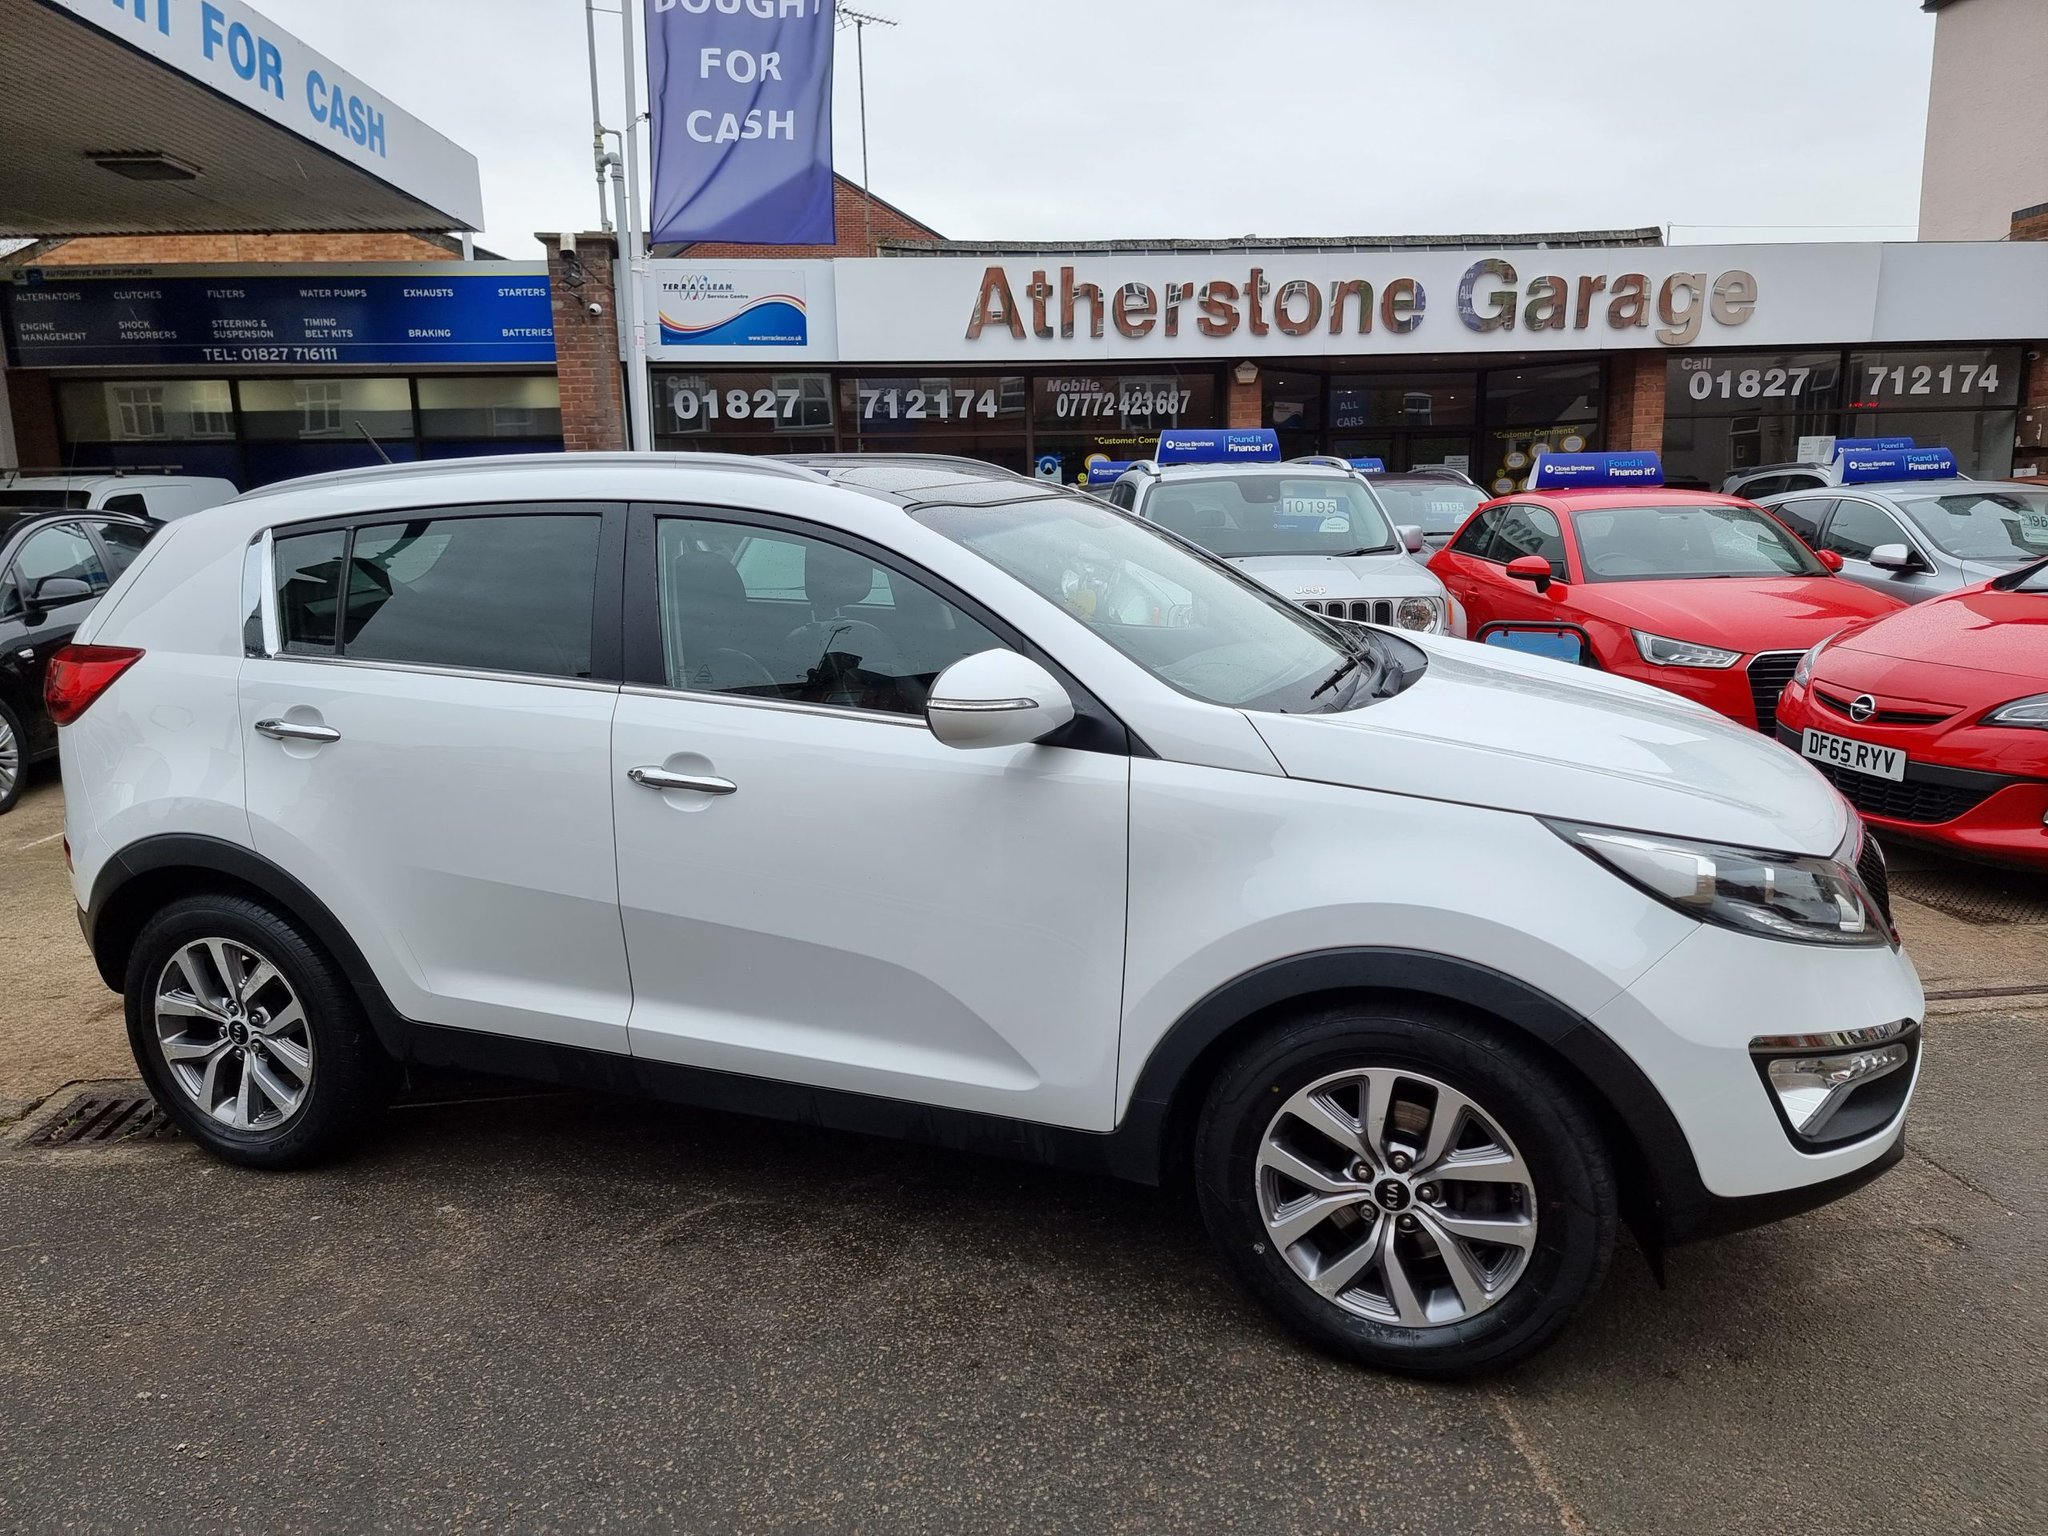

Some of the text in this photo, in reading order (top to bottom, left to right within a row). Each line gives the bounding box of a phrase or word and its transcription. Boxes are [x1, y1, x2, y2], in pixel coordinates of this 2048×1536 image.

[700, 48, 782, 83] FOR
[202, 1, 386, 158] FOR CASH
[686, 110, 794, 143] CASH
[16, 292, 81, 301] ALTERNATORS
[114, 290, 162, 299] CLUTCHES
[207, 289, 245, 298] FILTERS
[300, 289, 367, 297] WATER PUMPS
[403, 289, 454, 297] EXHAUSTS
[498, 288, 546, 297] STARTERS
[965, 258, 1757, 346] Atherstone Garage
[20, 322, 55, 331] ENGINE
[118, 320, 150, 329] SHOCK
[212, 319, 267, 328] STEERING &
[303, 318, 337, 326] TIMING
[22, 332, 87, 341] MANAGEMENT
[120, 330, 177, 339] ABSORBERS
[213, 330, 274, 338] SUSPENSION
[305, 329, 353, 338] BELT KITS
[408, 329, 451, 337] BRAKING
[502, 328, 553, 337] BATTERIES
[202, 347, 338, 361] TEL: 01827 716111
[1681, 357, 1712, 370] Call
[666, 376, 699, 388] Call
[1047, 379, 1100, 392] Mobile
[1688, 364, 1999, 400] 01827 712174
[674, 389, 998, 419] 01827 712174
[1056, 391, 1115, 417] 07772
[1337, 416, 1364, 427] CARS
[1228, 435, 1261, 443] Found it
[1228, 443, 1273, 452] Finance it?
[1609, 458, 1643, 467] Found it
[1908, 461, 1950, 470] Finance it?
[1609, 467, 1656, 476] Finance it?
[1285, 500, 1336, 514] 10195
[1432, 503, 1464, 511] 11195
[1295, 585, 1326, 595] Jeep
[1809, 732, 1896, 773] DF65 RYV
[1386, 1183, 1399, 1208] KIA
